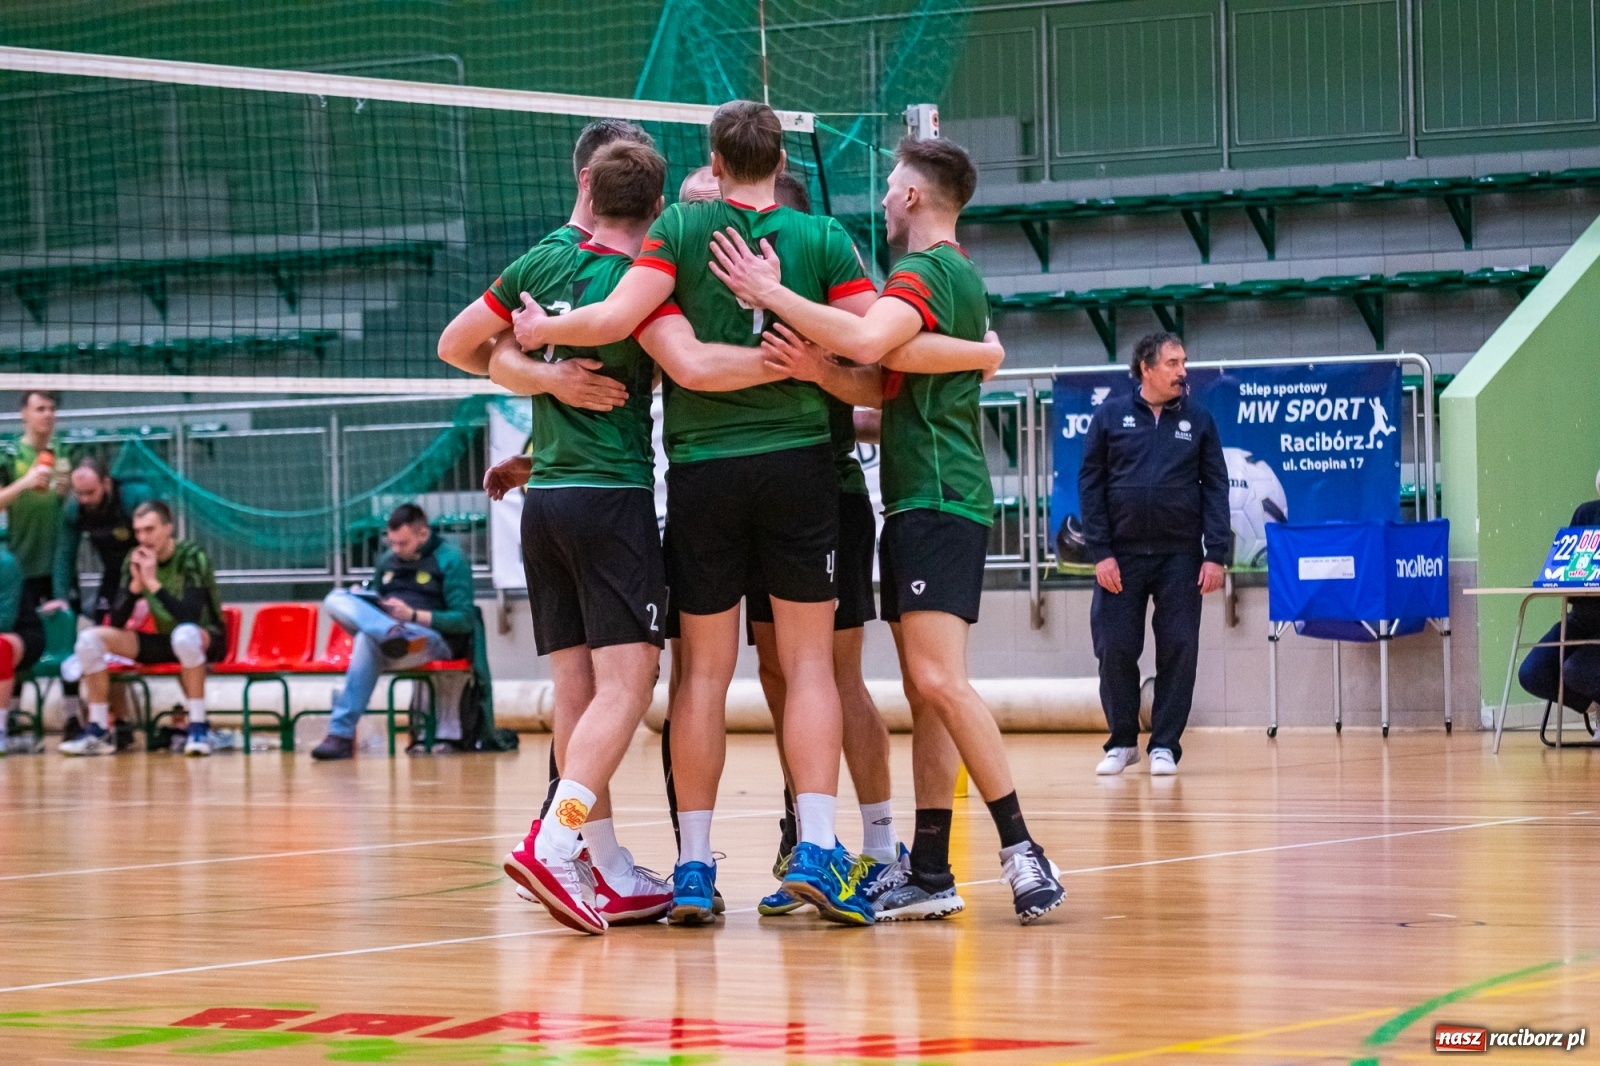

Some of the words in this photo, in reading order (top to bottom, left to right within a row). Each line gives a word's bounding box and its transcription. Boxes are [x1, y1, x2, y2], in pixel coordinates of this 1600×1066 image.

[1239, 383, 1271, 397] Sklep
[1273, 383, 1327, 397] sportowy
[1237, 400, 1280, 424] MW
[1285, 397, 1365, 422] SPORT
[1062, 413, 1094, 438] JO
[1280, 430, 1365, 452] Racibórz
[1283, 458, 1298, 471] ul.
[1300, 458, 1347, 472] Chopina
[1349, 457, 1364, 469] 17
[1553, 534, 1578, 560] 22
[826, 550, 836, 583] 4
[1396, 555, 1443, 578] molten
[646, 603, 659, 631] 2
